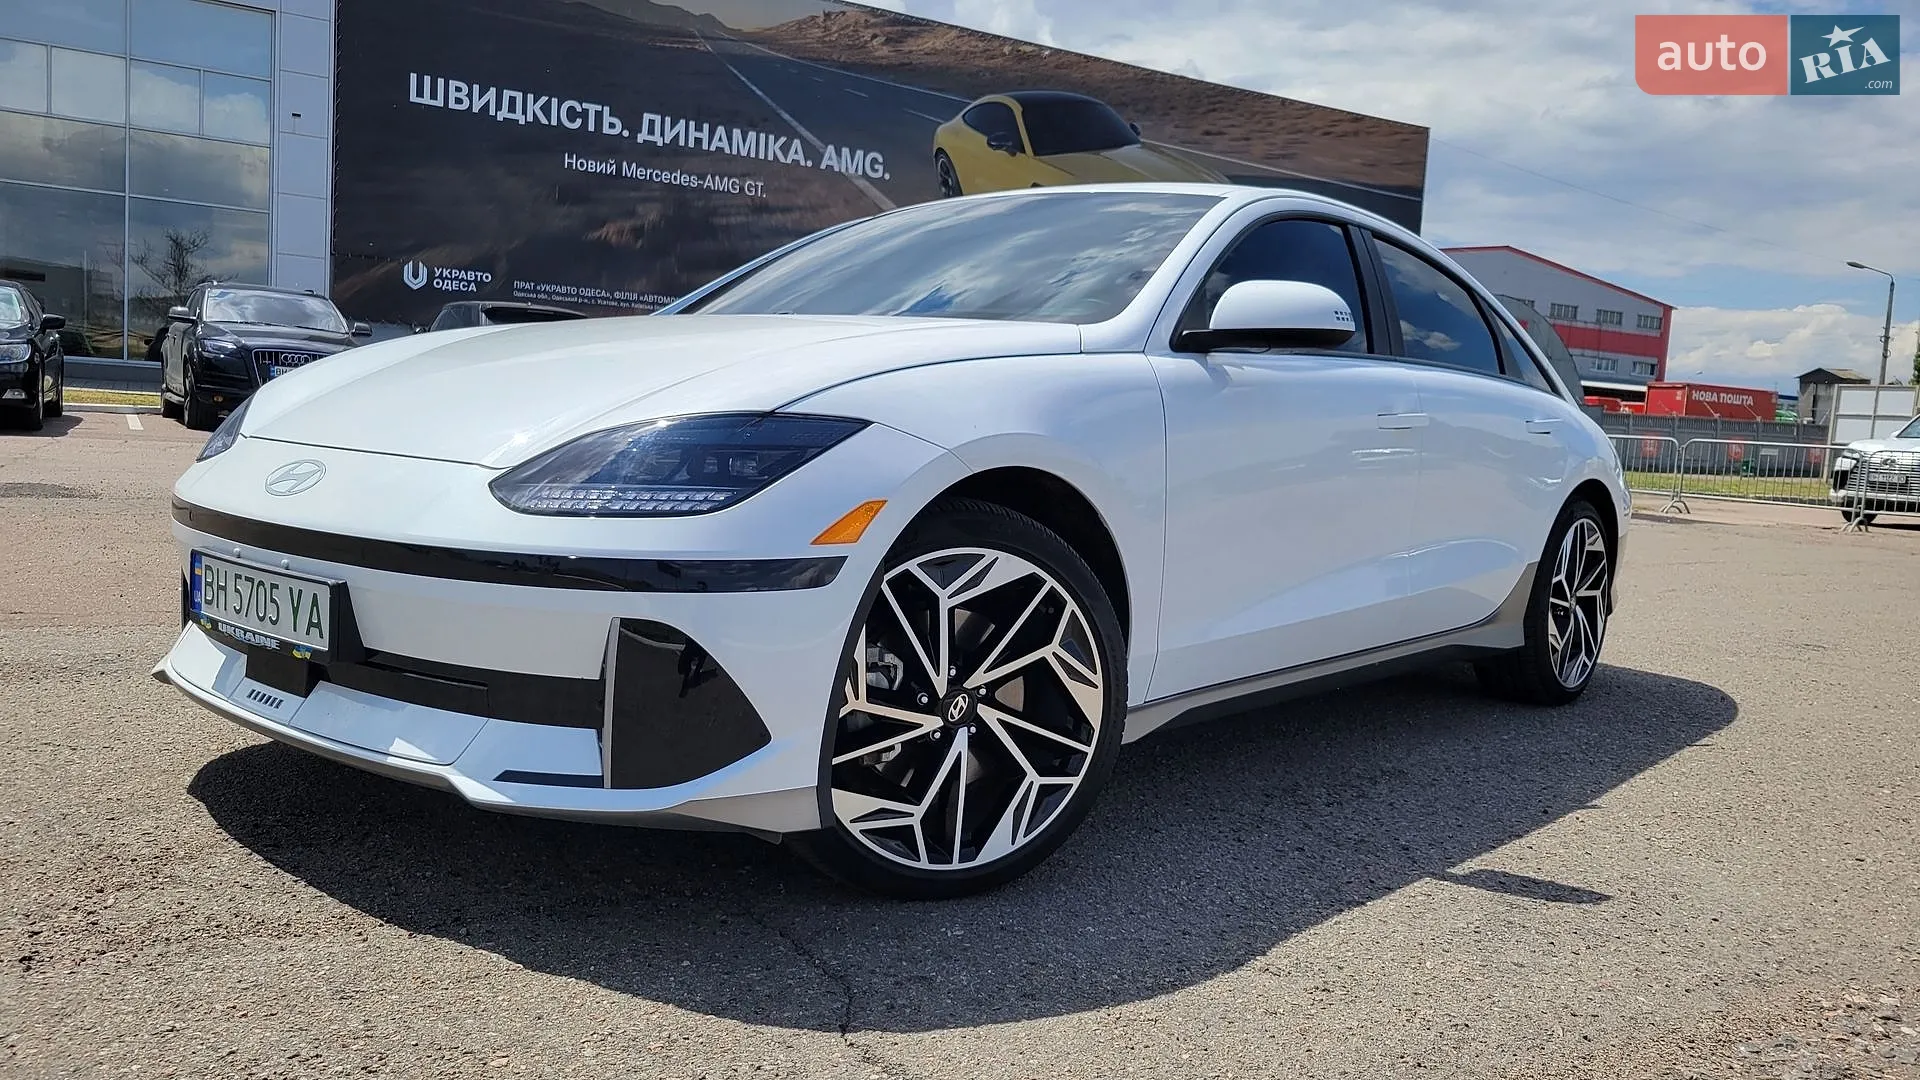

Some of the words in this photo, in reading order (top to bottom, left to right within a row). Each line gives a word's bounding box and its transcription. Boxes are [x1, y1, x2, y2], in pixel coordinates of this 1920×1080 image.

[409, 72, 630, 138] ШВИДКІСТЬ.
[637, 112, 813, 168] ДИНАМІКА.
[820, 144, 890, 180] AMG.
[564, 152, 616, 176] Новий
[622, 160, 740, 194] Mercedes-AMG
[744, 181, 767, 198] GT.
[433, 266, 492, 283] УКРАВТО
[433, 278, 477, 293] ОДЕСА
[513, 280, 535, 290] ПРАТ
[614, 291, 638, 301] ФІЛІЯ
[1692, 390, 1718, 403] НОВА
[1719, 393, 1754, 406] ПОШТА
[204, 564, 228, 612] BH
[233, 572, 280, 626] 5705
[289, 586, 324, 639] YA
[218, 622, 281, 650] UKRAINE
